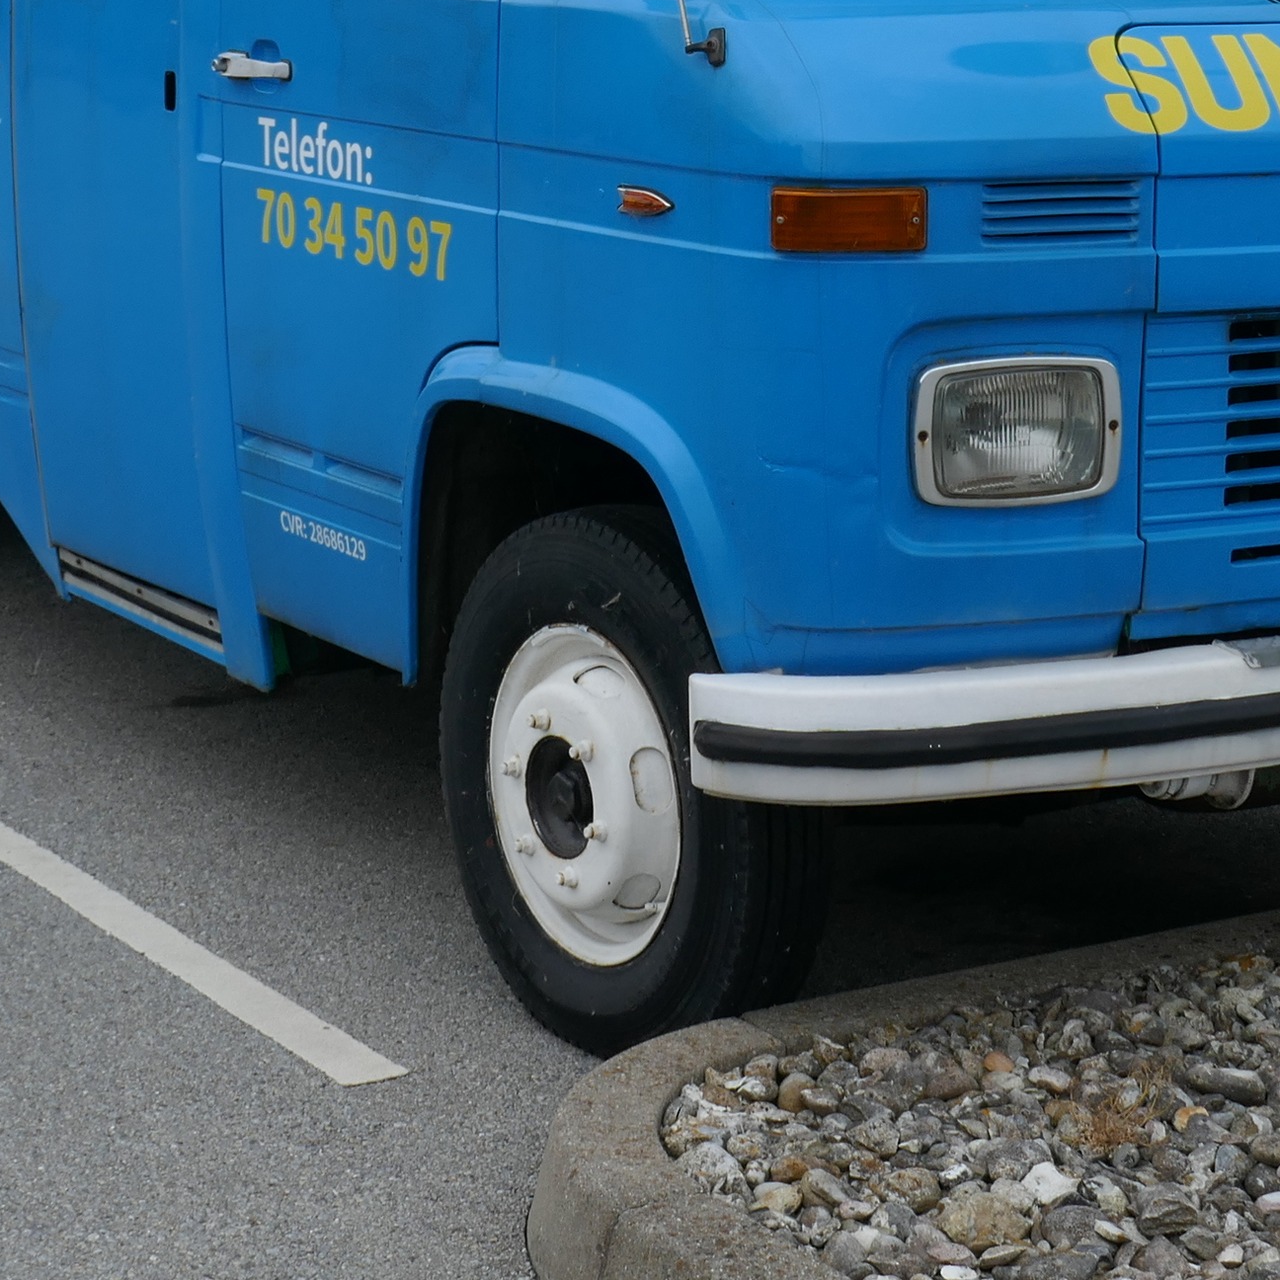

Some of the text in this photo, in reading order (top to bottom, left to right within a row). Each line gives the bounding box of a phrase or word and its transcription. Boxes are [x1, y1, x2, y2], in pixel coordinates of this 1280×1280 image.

[258, 116, 373, 185] Telefon:
[256, 188, 452, 281] 70 34 50 97
[280, 510, 366, 561] CVR: 28686129
